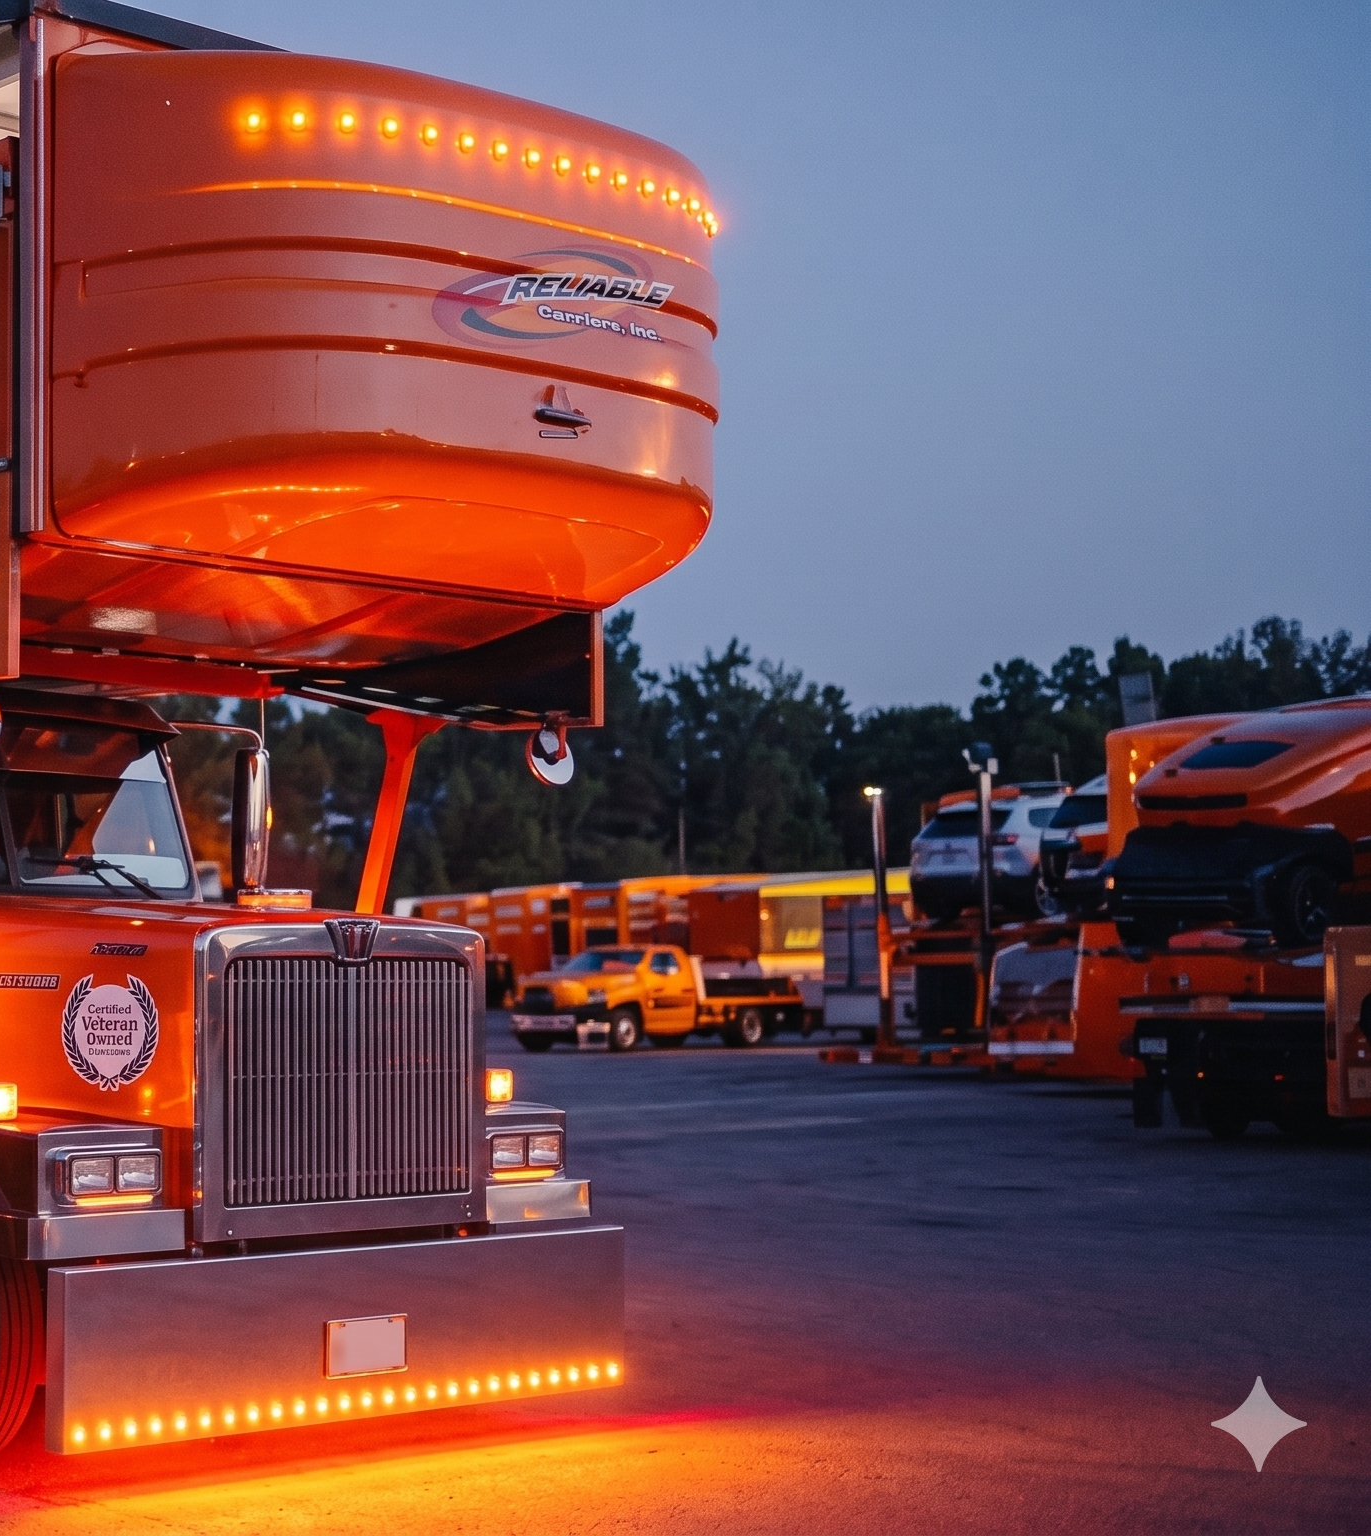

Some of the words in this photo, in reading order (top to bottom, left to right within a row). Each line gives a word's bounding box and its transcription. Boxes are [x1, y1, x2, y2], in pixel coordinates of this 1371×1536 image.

[504, 273, 672, 306] RELIABLE
[629, 322, 663, 341] Inc.
[87, 1003, 132, 1015] Certified
[81, 1015, 139, 1032] Veteran
[86, 1031, 133, 1046] Owned
